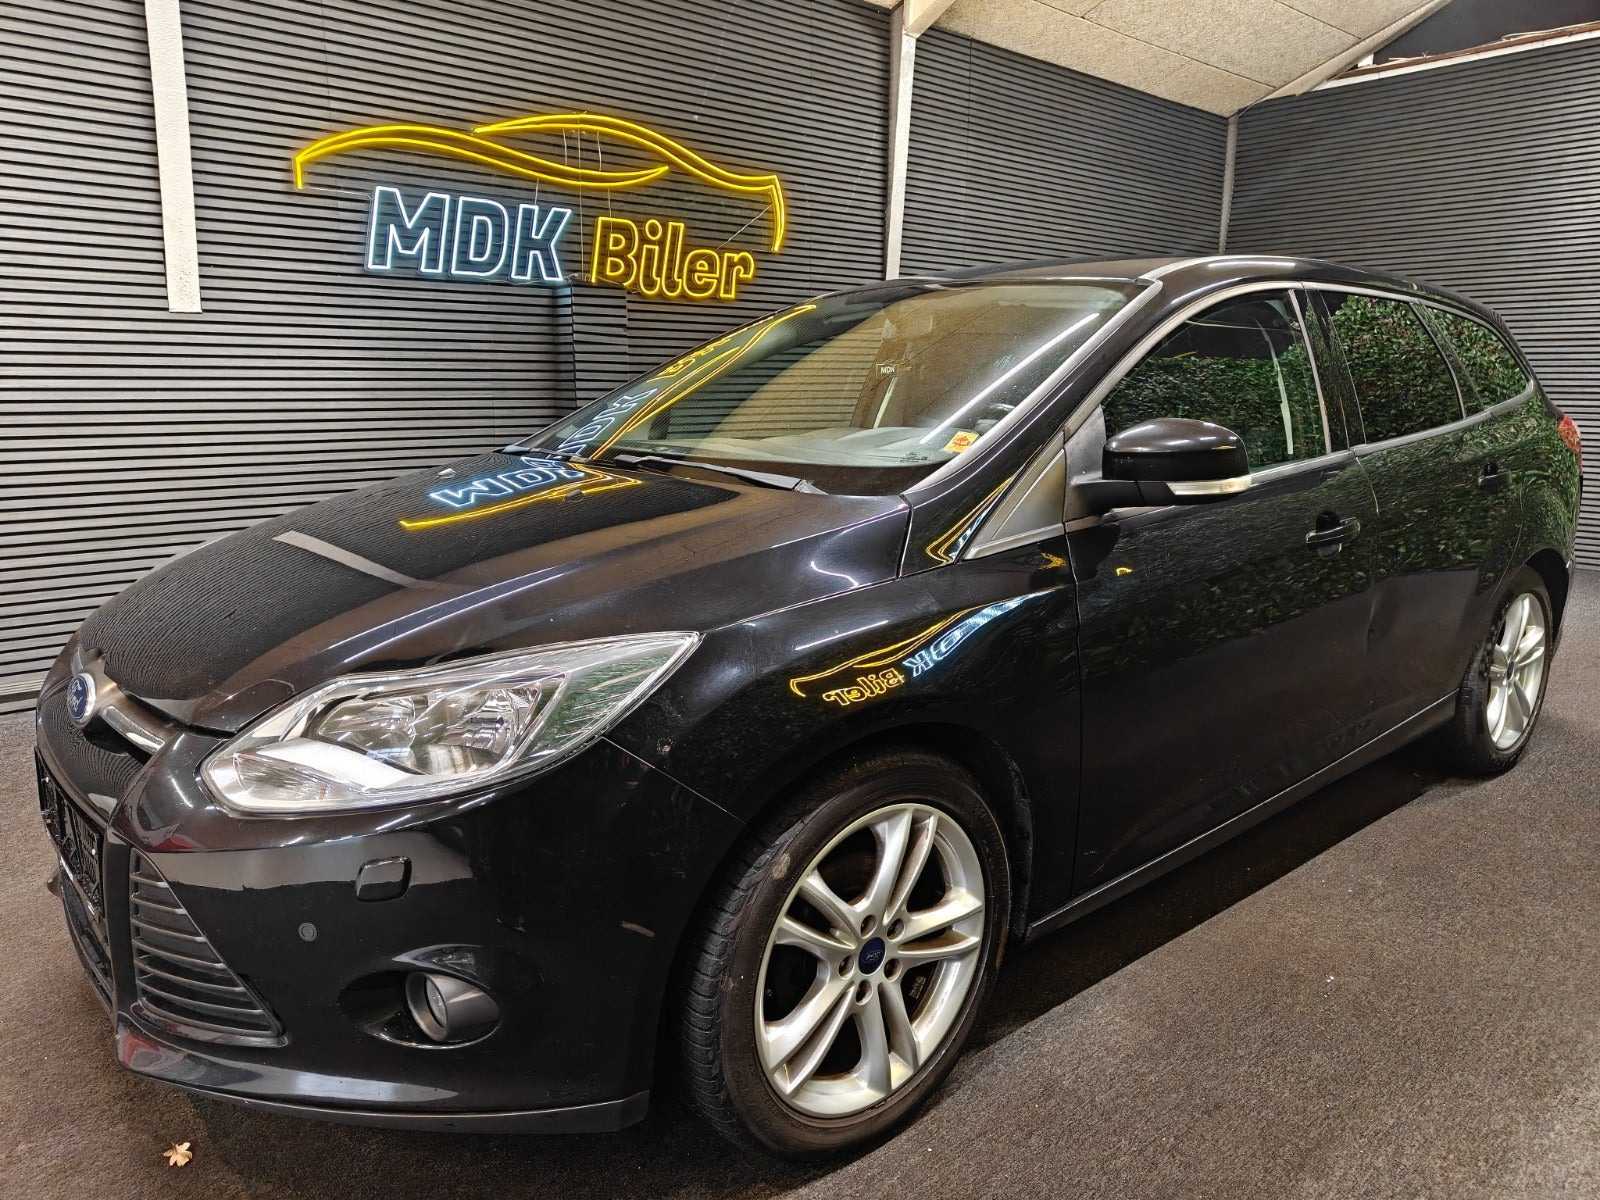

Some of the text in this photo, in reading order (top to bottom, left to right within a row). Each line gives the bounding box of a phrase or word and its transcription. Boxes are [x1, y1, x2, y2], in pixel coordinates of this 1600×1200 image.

[367, 186, 755, 299] MDK Biler
[880, 366, 895, 374] MDK
